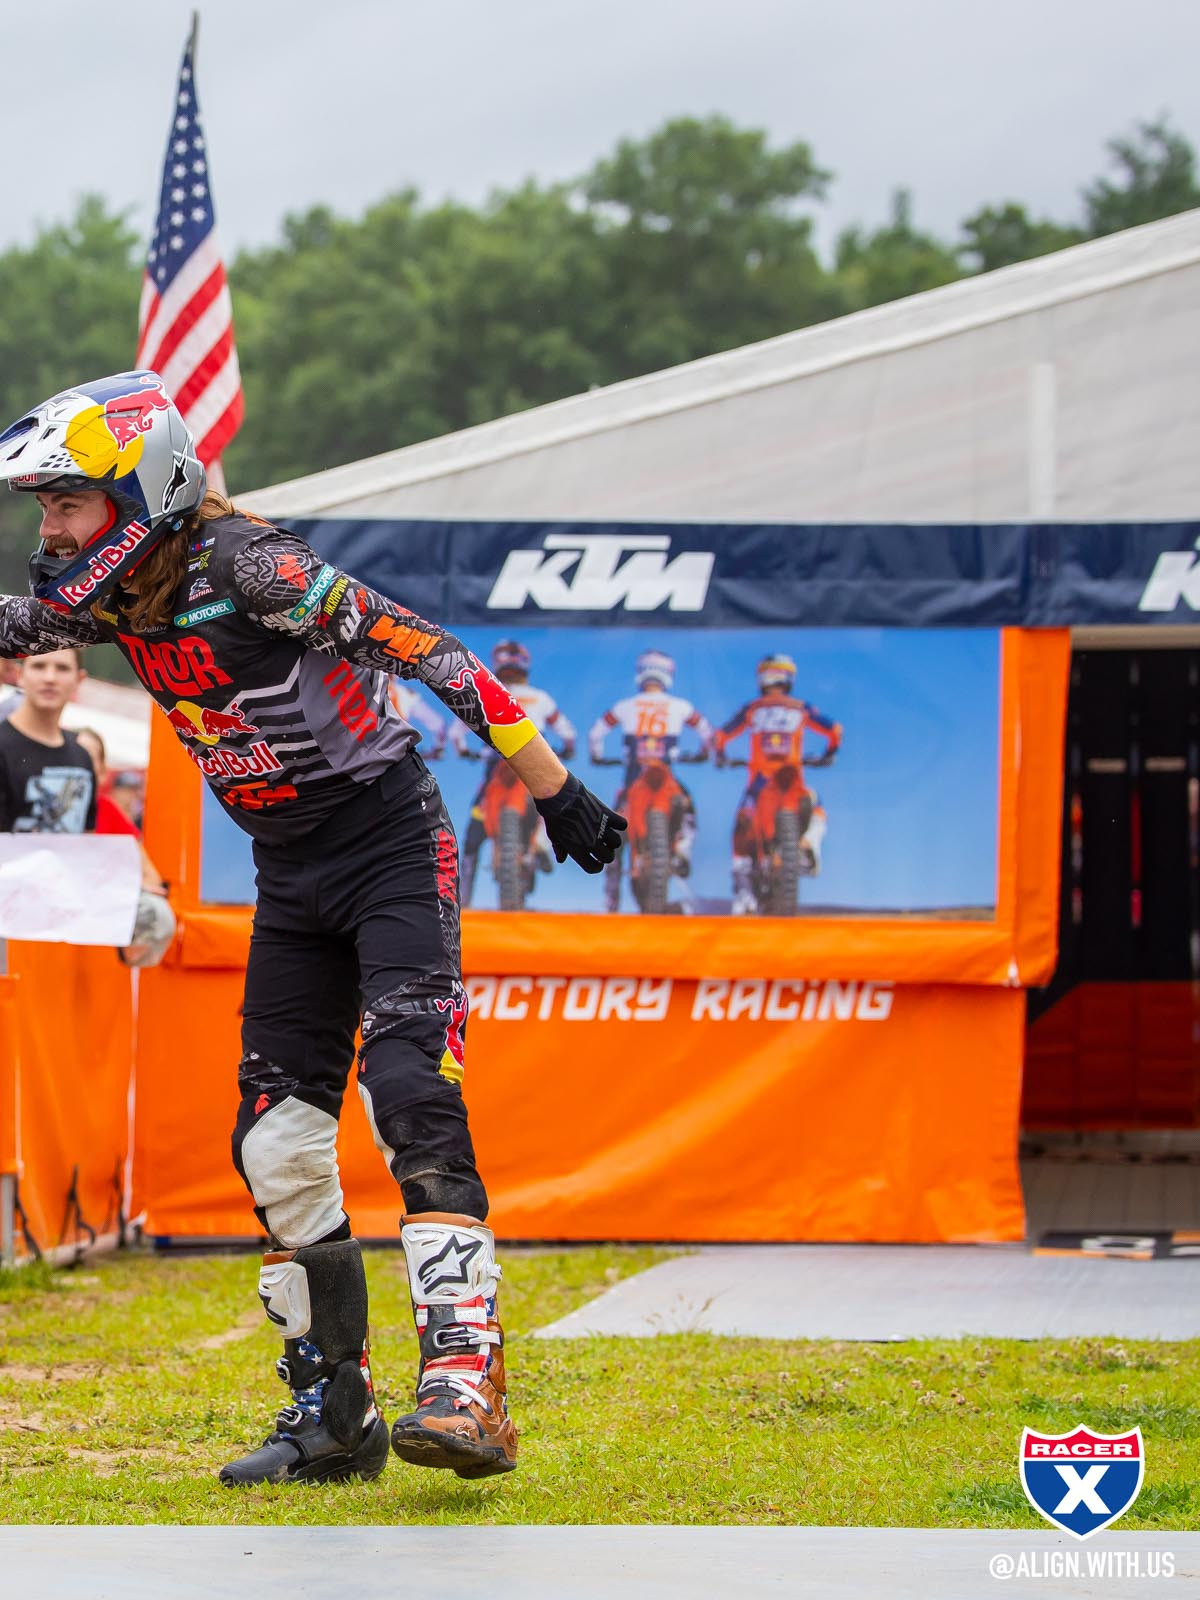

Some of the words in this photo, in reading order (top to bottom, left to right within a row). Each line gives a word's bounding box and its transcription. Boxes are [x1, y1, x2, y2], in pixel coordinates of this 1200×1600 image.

[57, 557, 112, 606] Red
[99, 520, 150, 569] Bull
[486, 534, 715, 611] KTM
[188, 603, 230, 623] MOTOREX
[116, 631, 234, 697] THOR
[217, 741, 285, 778] Bull
[465, 976, 672, 1021] ACTORY
